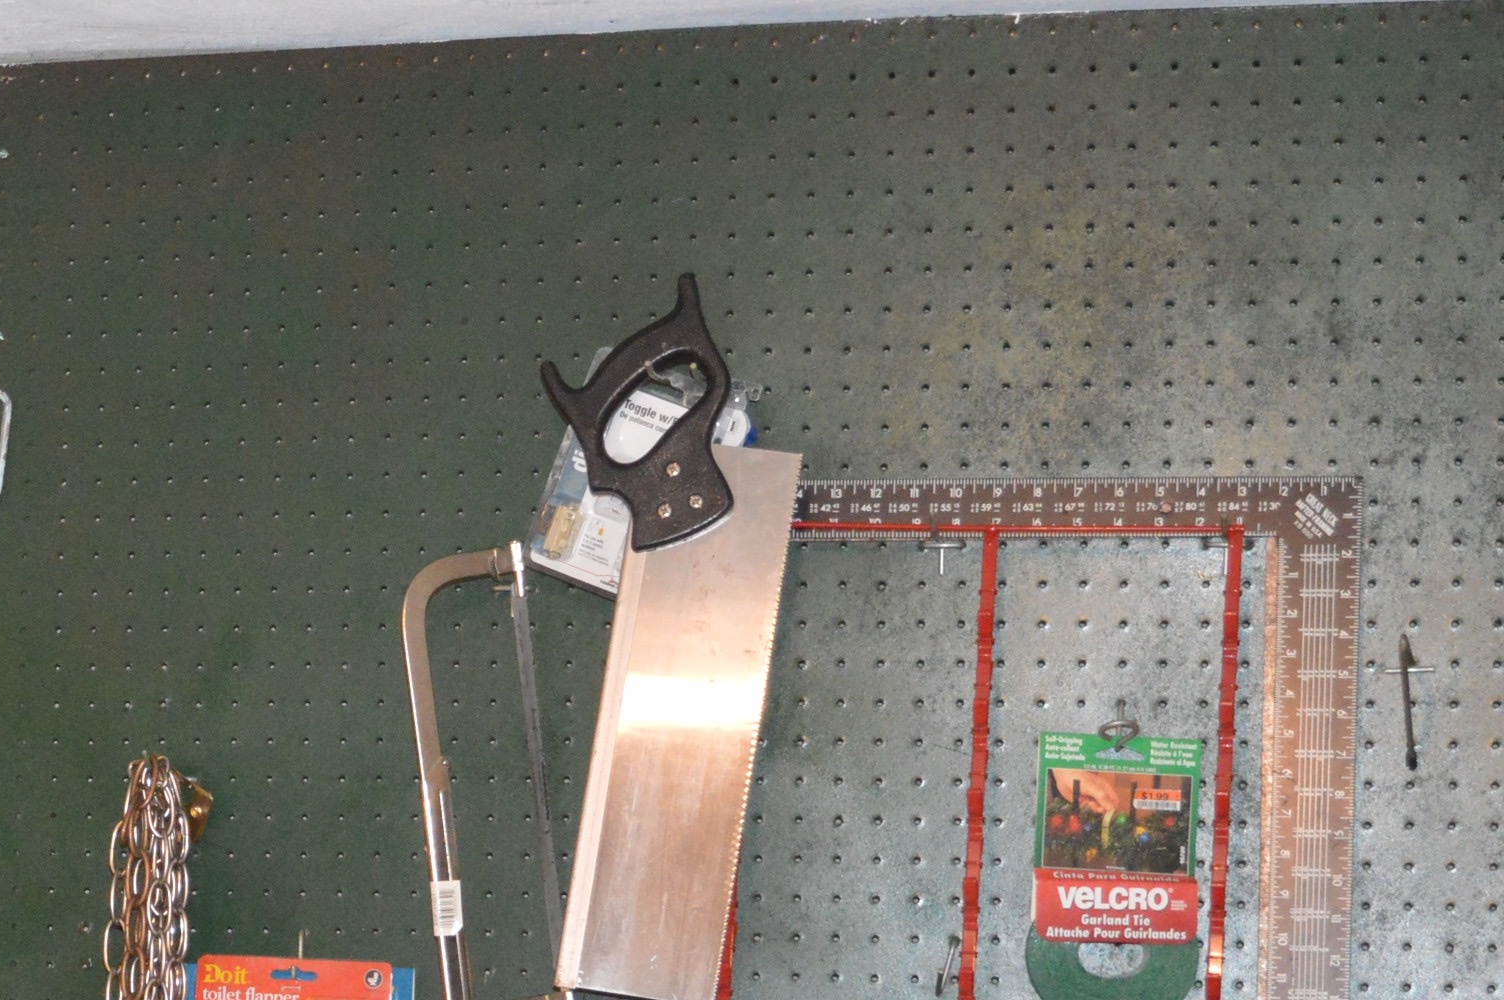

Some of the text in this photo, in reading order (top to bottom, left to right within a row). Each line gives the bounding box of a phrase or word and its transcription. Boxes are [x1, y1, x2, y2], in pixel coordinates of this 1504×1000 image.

[624, 399, 656, 419] Toggle
[830, 488, 842, 498] 13
[870, 488, 882, 498] 12
[950, 487, 962, 498] 10
[995, 487, 1002, 497] 9
[1036, 487, 1042, 497] 8
[1076, 487, 1083, 497] 7
[1116, 487, 1124, 497] 6
[1158, 487, 1165, 497] 5
[1199, 487, 1206, 497] 4
[1240, 486, 1247, 496] 3
[1281, 486, 1288, 496] 2
[820, 502, 1240, 512] 42 46 50 55 59 63 67 72 80 84
[1141, 792, 1169, 800] $1.99
[1053, 871, 1084, 880] Cinta
[1088, 872, 1116, 880] Para
[1332, 874, 1342, 887] 10
[1081, 914, 1151, 926] Garland Tie
[1046, 926, 1187, 940] Attache Pour Guirlandes
[1330, 955, 1340, 967] 12
